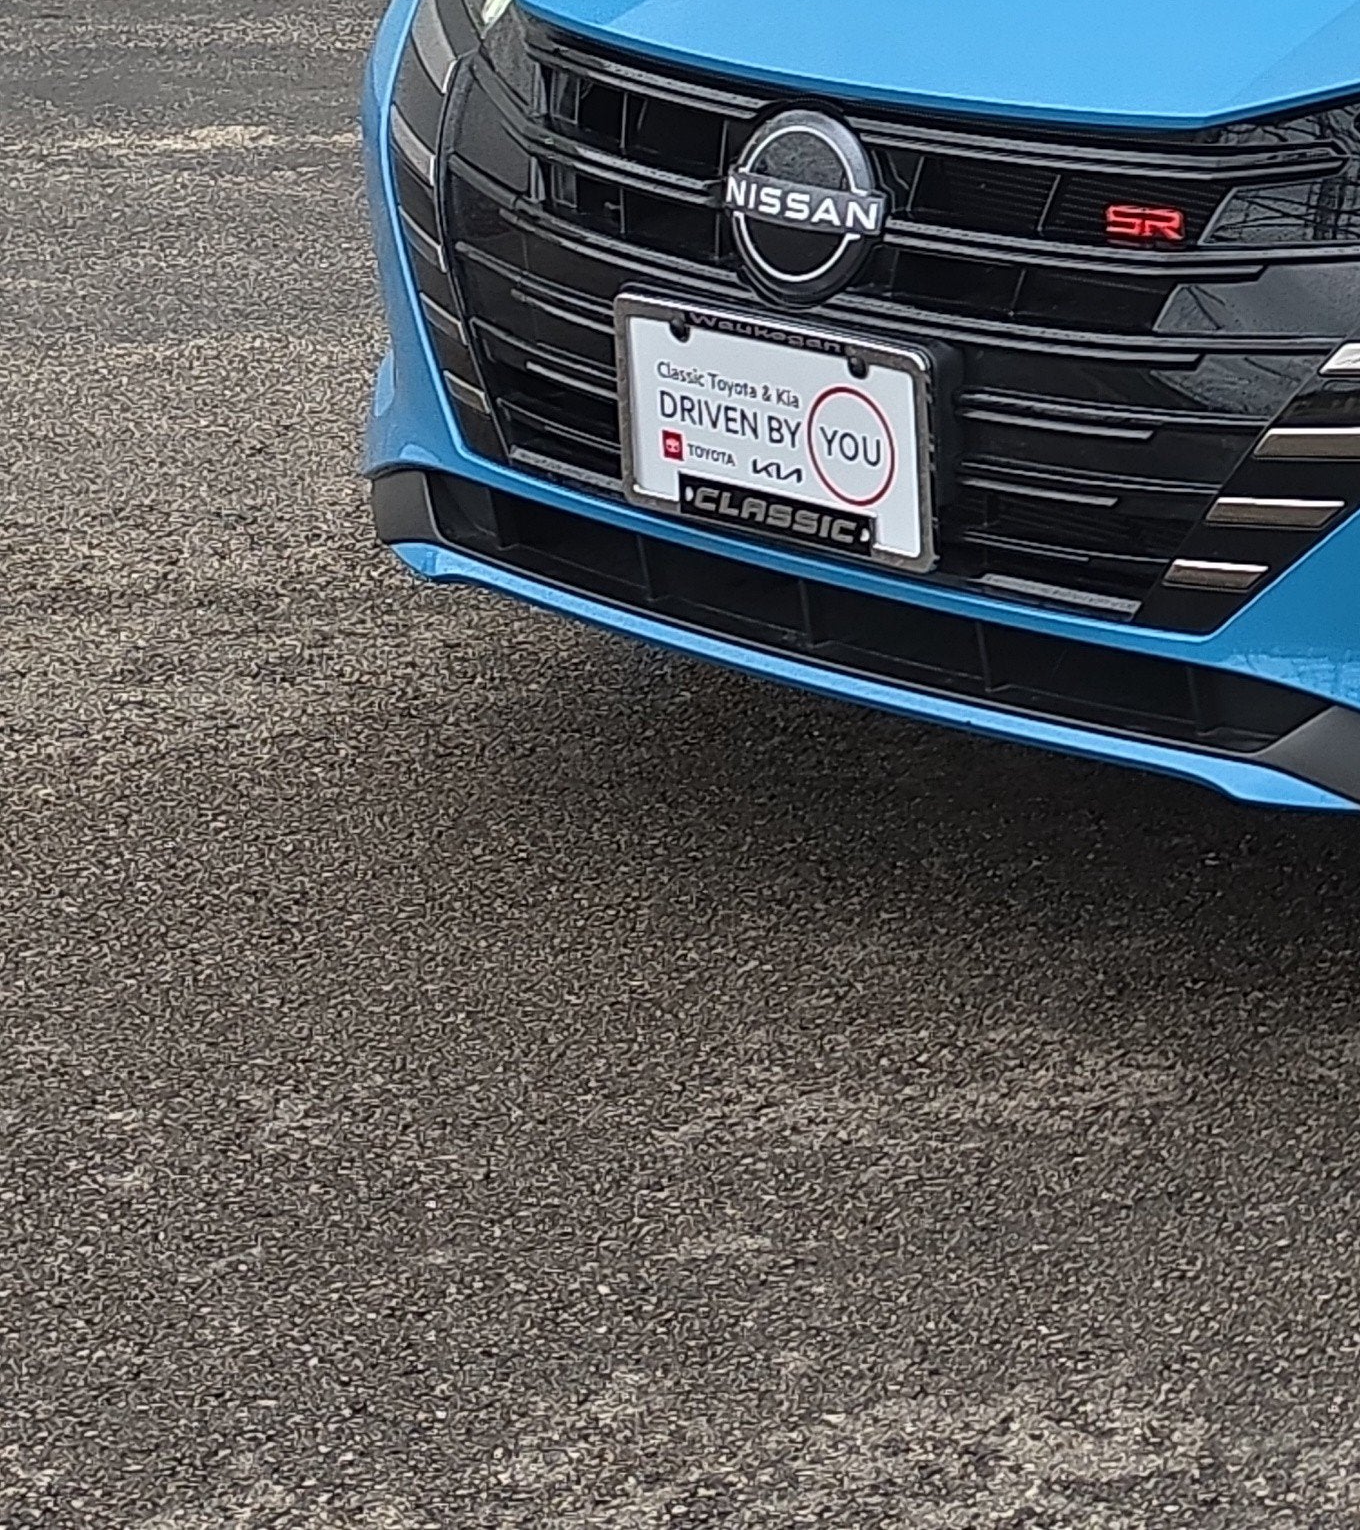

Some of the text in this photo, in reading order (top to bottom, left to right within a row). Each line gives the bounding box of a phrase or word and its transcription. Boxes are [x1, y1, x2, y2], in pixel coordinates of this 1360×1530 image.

[726, 176, 880, 230] NISSAN
[1106, 205, 1185, 241] SR
[657, 361, 800, 409] Classic Toyota & Kia
[660, 390, 882, 467] DRIVEN BY YOU
[687, 442, 736, 467] TOYOTA
[695, 487, 858, 543] CLASSIC
